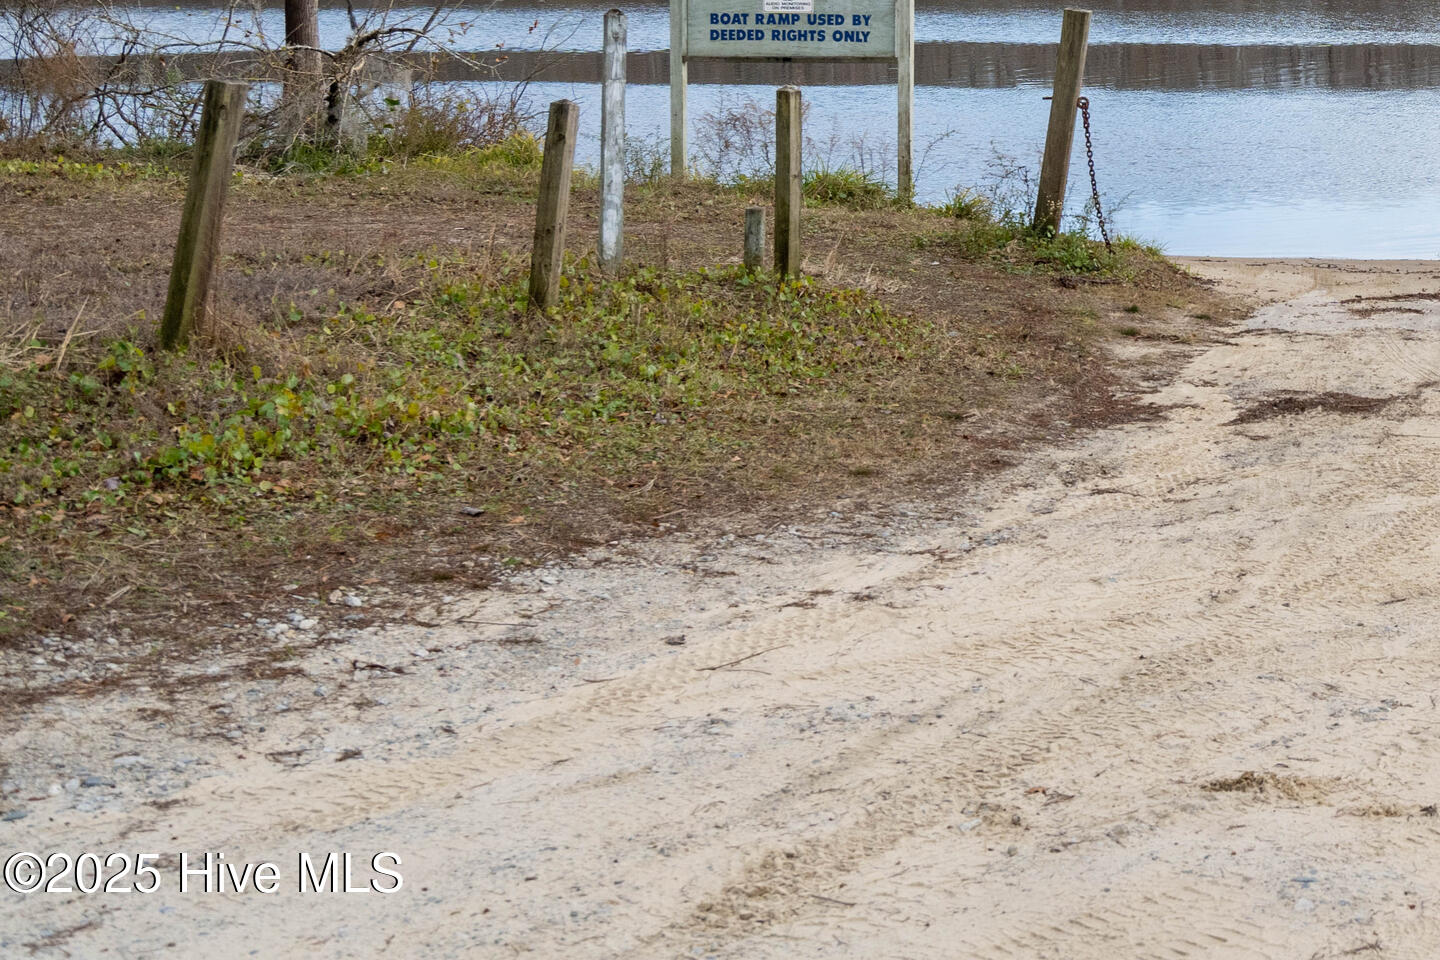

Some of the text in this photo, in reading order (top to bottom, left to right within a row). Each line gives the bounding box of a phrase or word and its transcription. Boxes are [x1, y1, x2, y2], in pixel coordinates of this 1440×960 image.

[710, 14, 872, 26] BOAT RAMP USED BY
[710, 30, 870, 42] DEEDED RIGHTS ONLY
